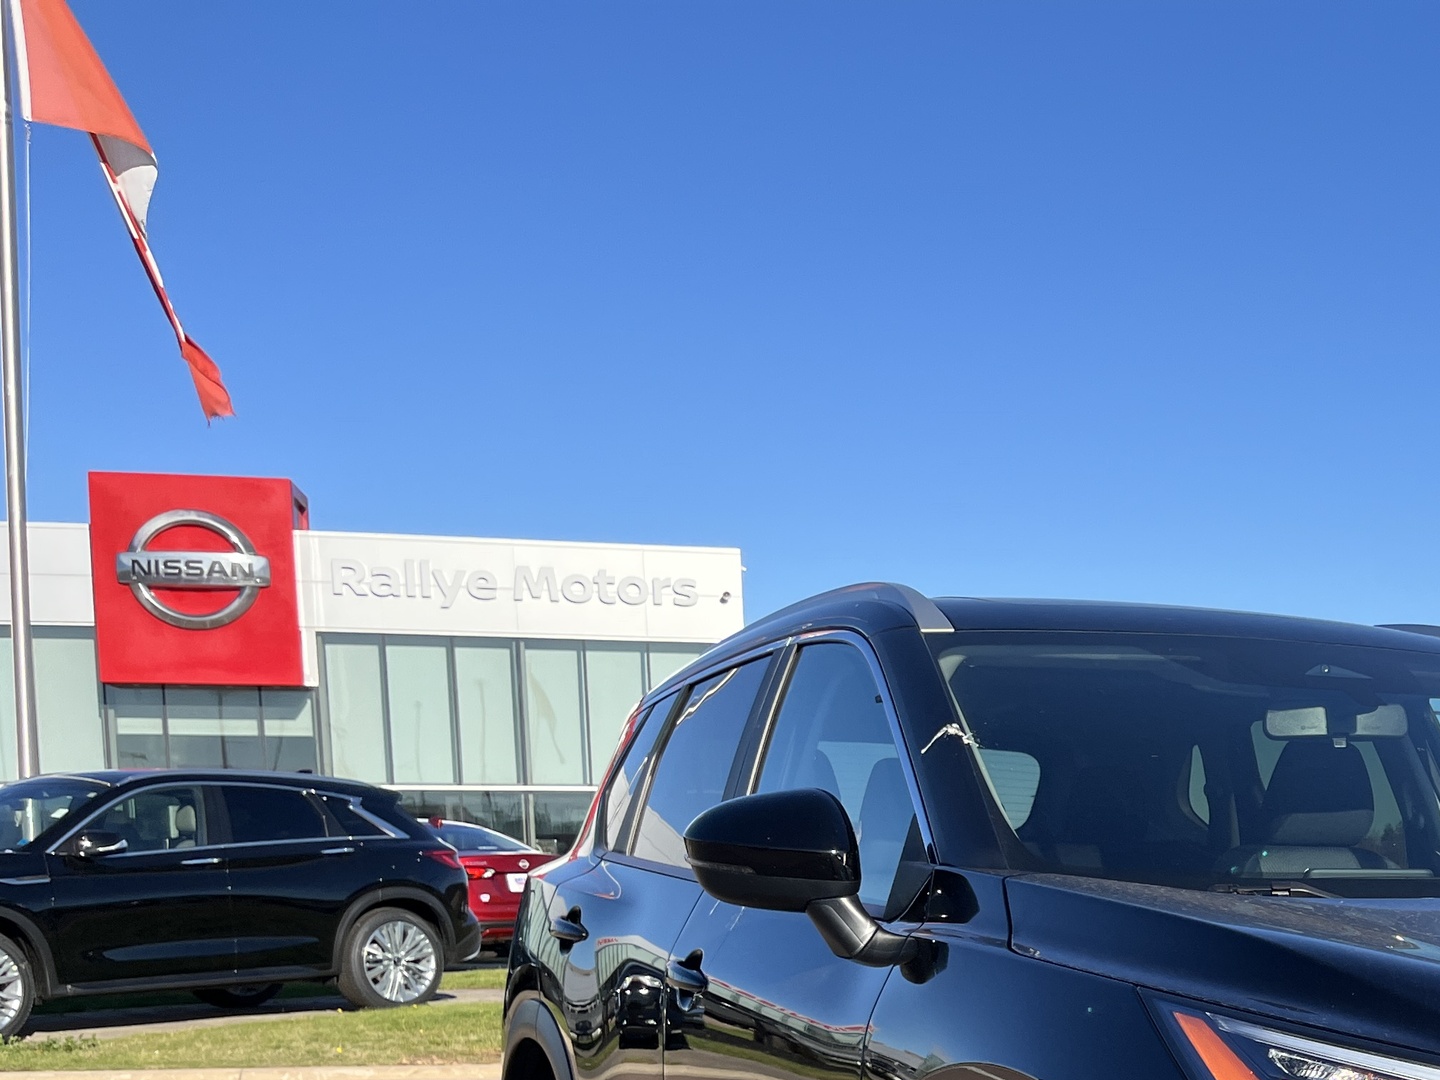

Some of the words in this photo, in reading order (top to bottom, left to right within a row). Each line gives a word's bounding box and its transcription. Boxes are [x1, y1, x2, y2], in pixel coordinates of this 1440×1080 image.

[131, 558, 255, 578] NISSAN
[331, 558, 498, 609] Rallye
[513, 565, 699, 607] Motors
